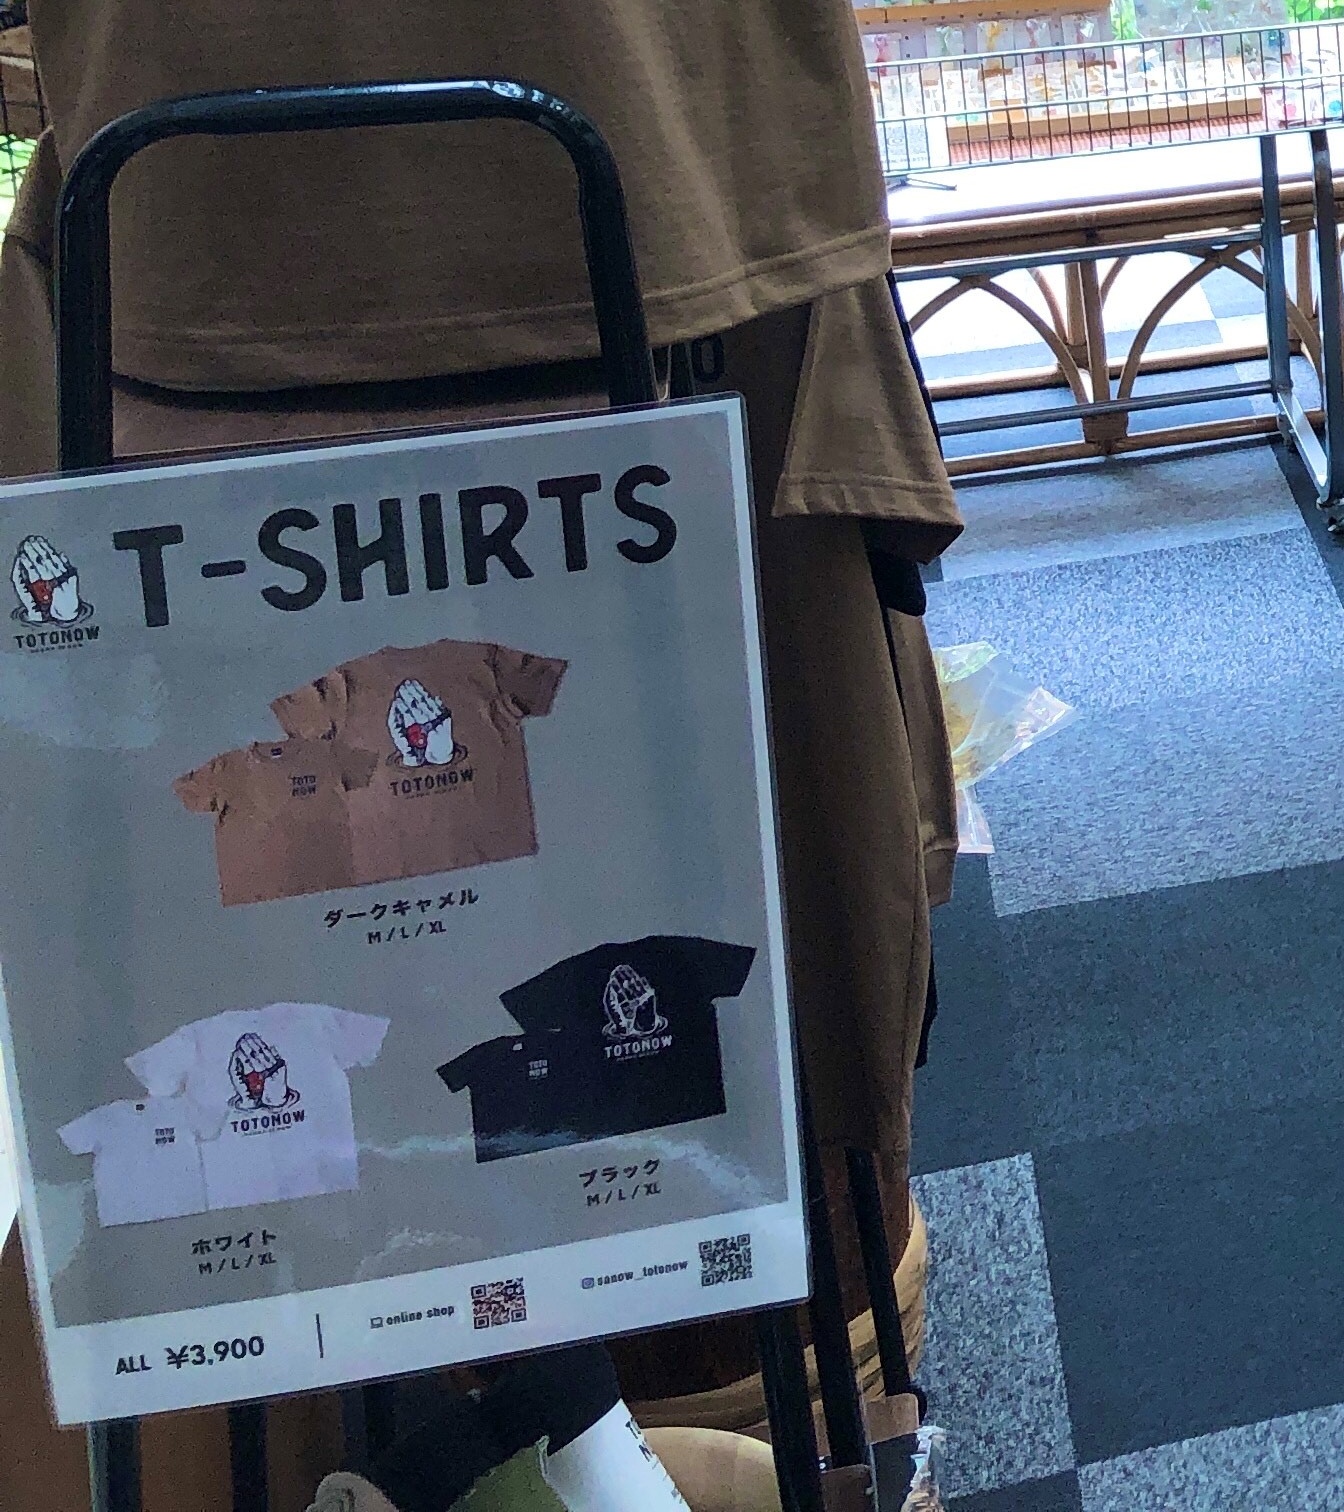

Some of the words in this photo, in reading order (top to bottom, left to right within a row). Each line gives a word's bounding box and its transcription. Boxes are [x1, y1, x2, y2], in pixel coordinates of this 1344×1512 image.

[112, 463, 679, 628] T-SHIRTS
[14, 626, 100, 650] TOTONOW
[389, 767, 475, 797] TOTONOW
[323, 887, 480, 929] ダークキャメル
[604, 1034, 673, 1059] TOTONOW
[230, 1109, 306, 1134] TOTONOW
[190, 1229, 278, 1257] ホワイト
[385, 1309, 424, 1328] online
[425, 1303, 456, 1321] shop
[114, 1354, 154, 1376] ALL
